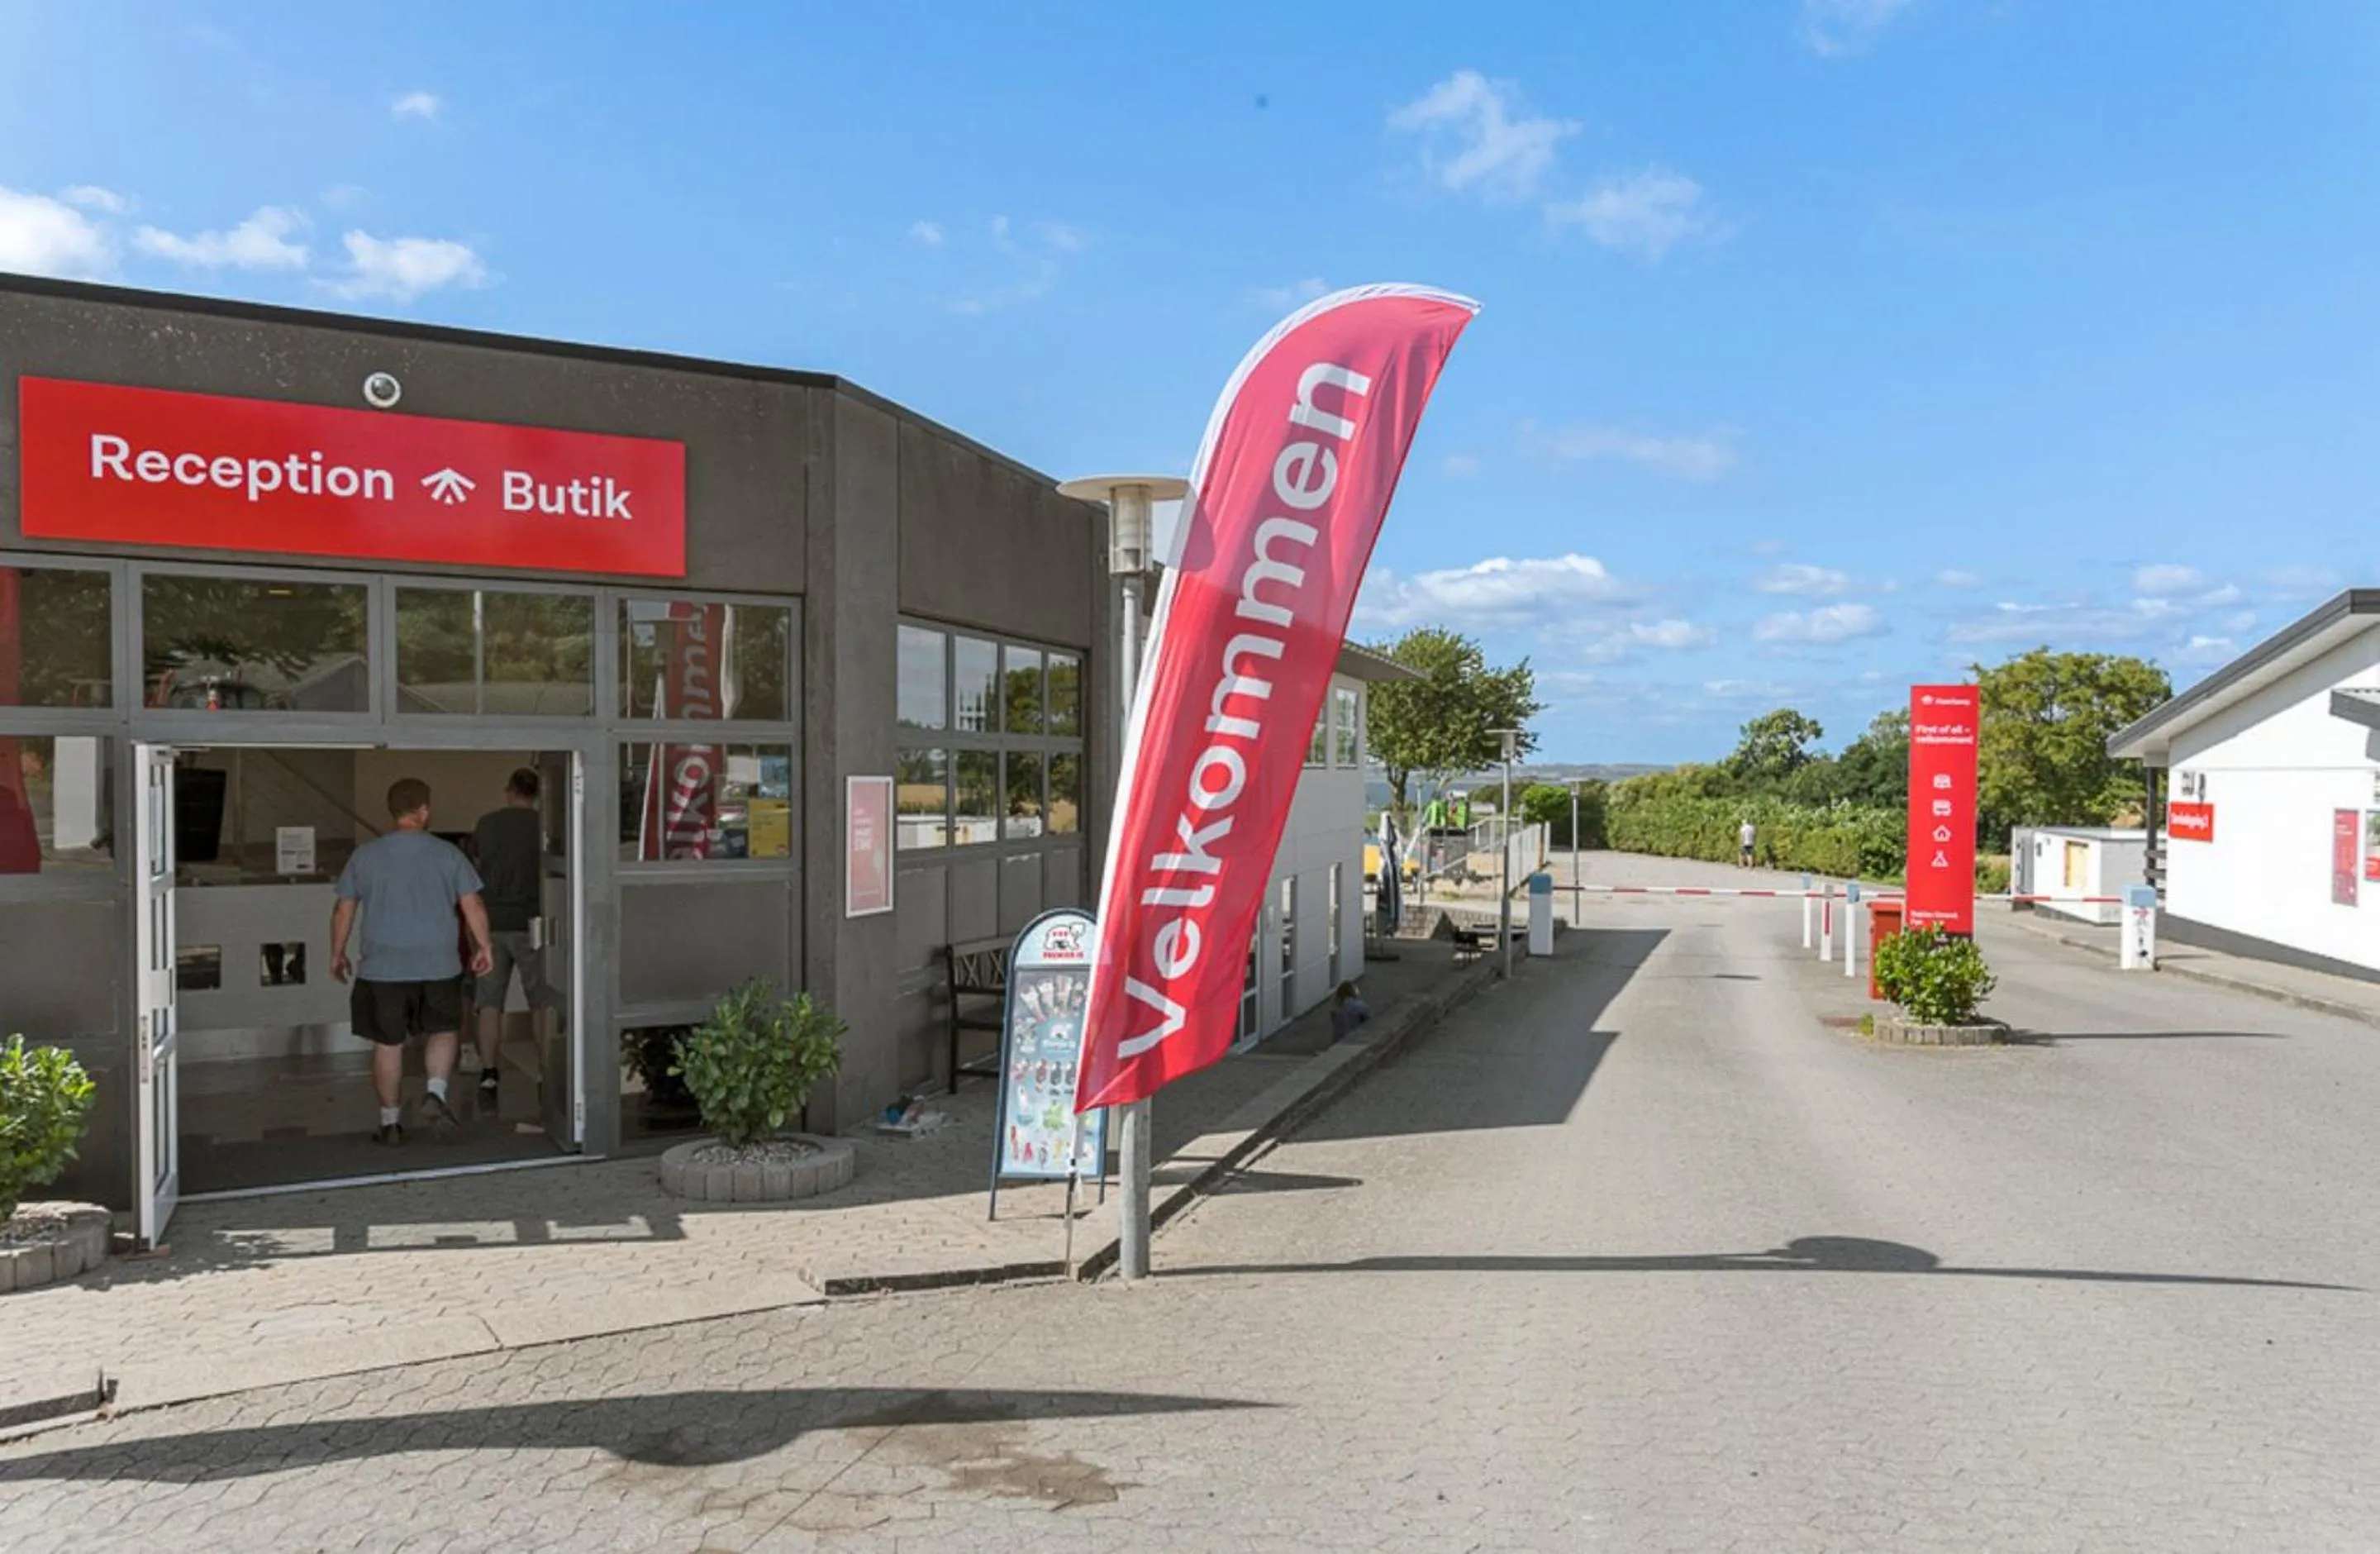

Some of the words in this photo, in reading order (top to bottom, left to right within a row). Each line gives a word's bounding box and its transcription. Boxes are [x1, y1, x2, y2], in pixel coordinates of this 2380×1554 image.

[91, 434, 394, 501] Reception
[502, 470, 632, 520] Butik
[1118, 360, 1372, 1059] Velkommen
